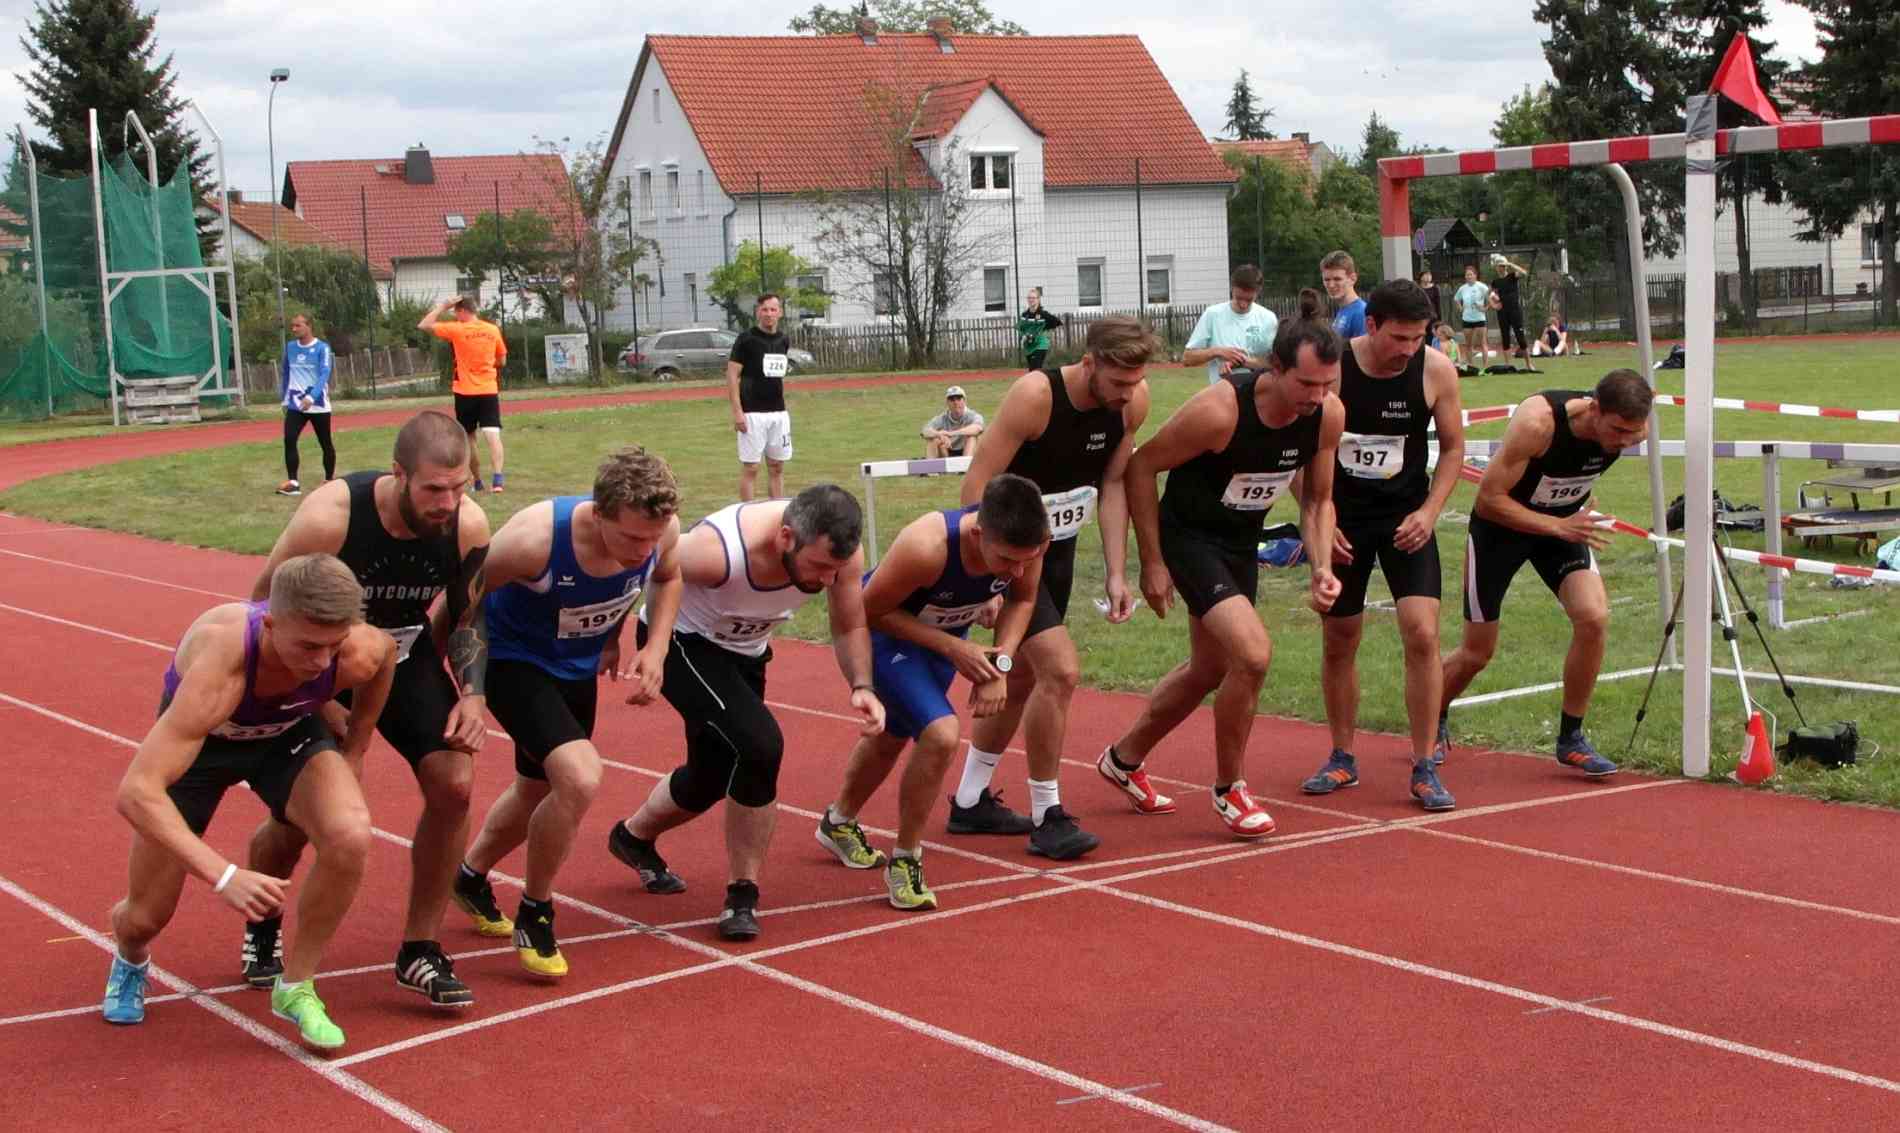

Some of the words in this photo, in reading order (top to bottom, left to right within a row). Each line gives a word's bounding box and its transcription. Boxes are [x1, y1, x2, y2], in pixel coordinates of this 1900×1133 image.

[1352, 449, 1388, 467] 197
[1241, 486, 1277, 500] 195
[1550, 486, 1583, 499] 196
[1052, 506, 1085, 527] 193
